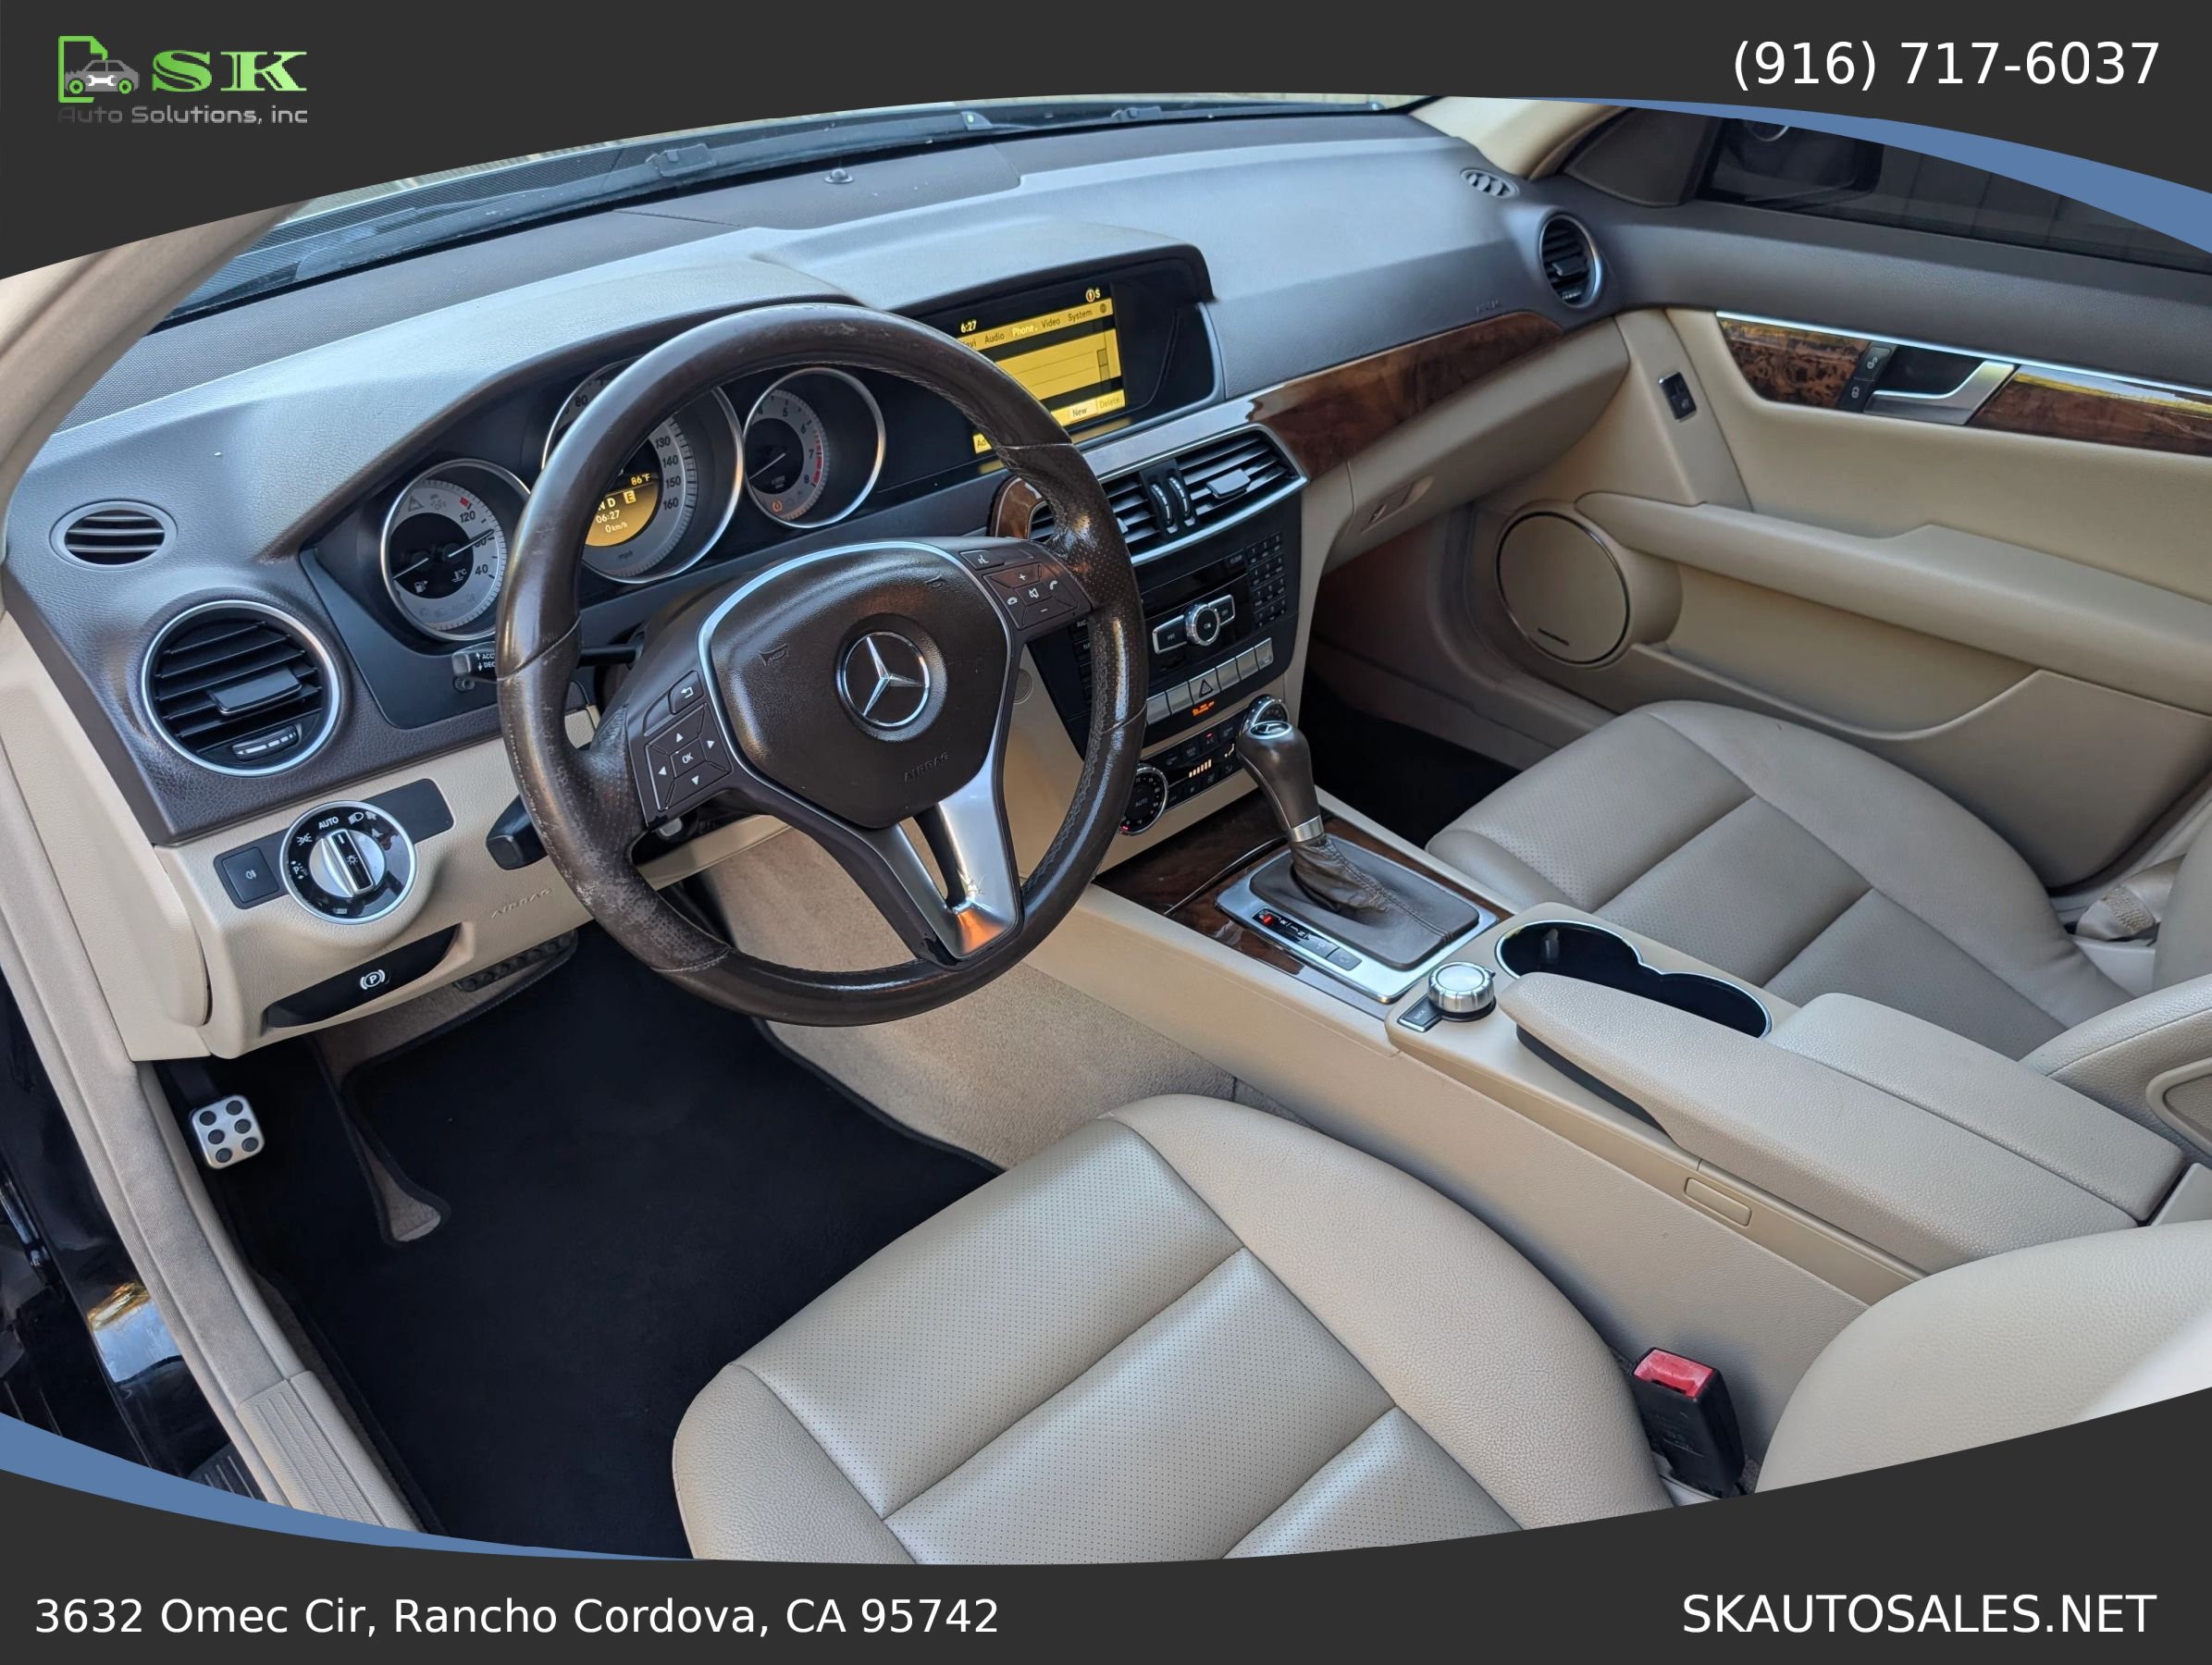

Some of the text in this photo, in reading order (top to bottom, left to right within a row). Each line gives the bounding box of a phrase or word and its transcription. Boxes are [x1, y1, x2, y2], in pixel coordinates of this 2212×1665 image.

[960, 318, 977, 333] 6:27
[984, 333, 1006, 344] Audio
[1012, 325, 1034, 338] Phone
[1042, 317, 1061, 328] Video
[1068, 310, 1093, 322] System
[575, 394, 588, 407] 80
[1073, 397, 1120, 417] New Delete
[655, 436, 671, 449] 130
[809, 449, 814, 459] 7
[662, 454, 679, 468] 140
[666, 475, 682, 488] 150
[607, 498, 616, 508] D
[663, 498, 679, 511] 160
[460, 510, 476, 524] 120
[595, 510, 620, 524] 06:27
[475, 563, 488, 575] 40
[682, 753, 694, 764] OK
[904, 752, 949, 783] AIRBAG
[318, 816, 340, 830] AUTO
